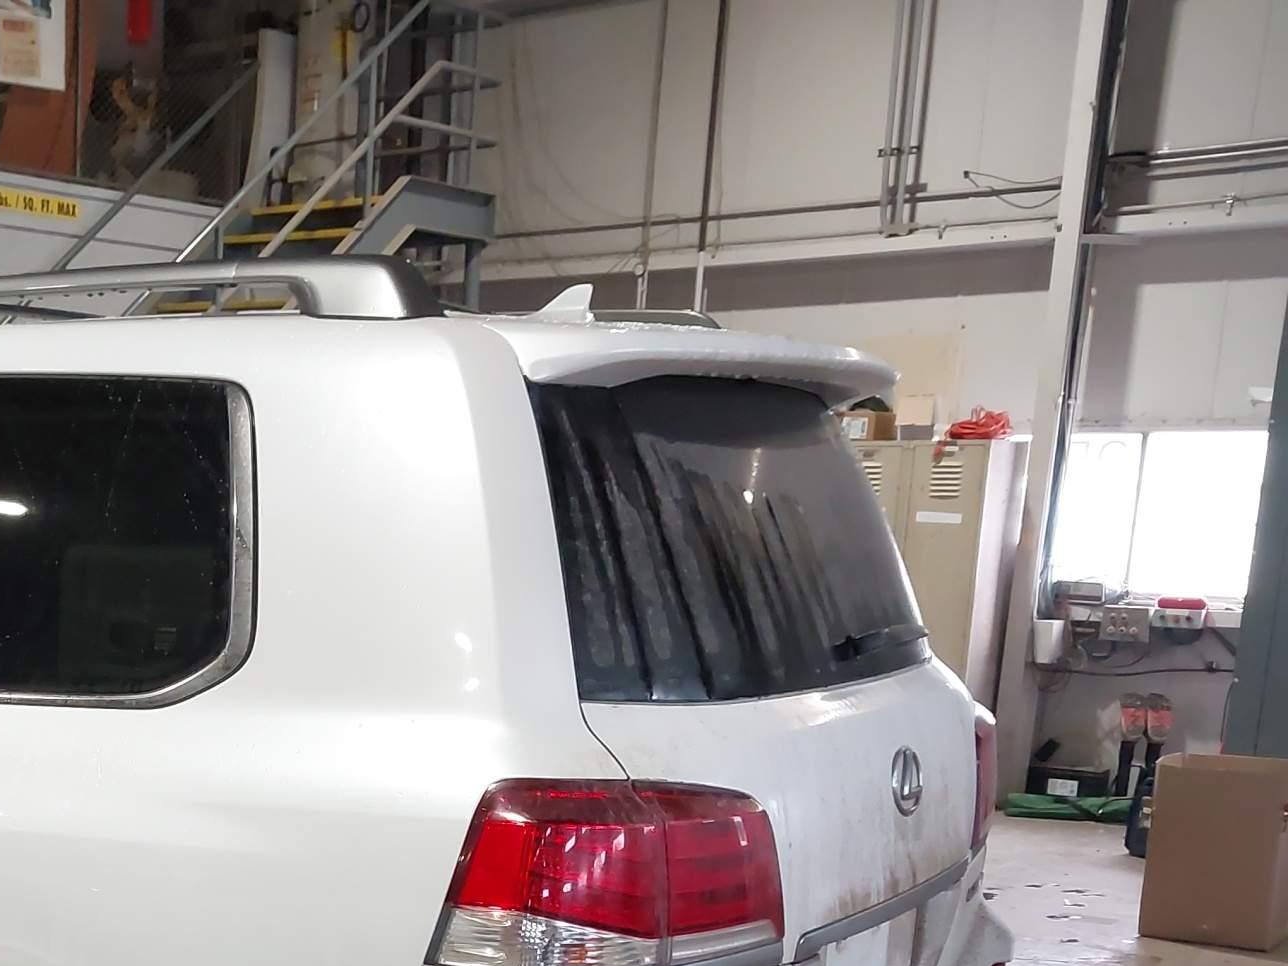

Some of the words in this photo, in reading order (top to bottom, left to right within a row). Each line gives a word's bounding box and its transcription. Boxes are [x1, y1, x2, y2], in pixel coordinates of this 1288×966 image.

[23, 195, 38, 212] SQ.
[41, 199, 53, 214] FT.
[57, 202, 77, 217] MAX
